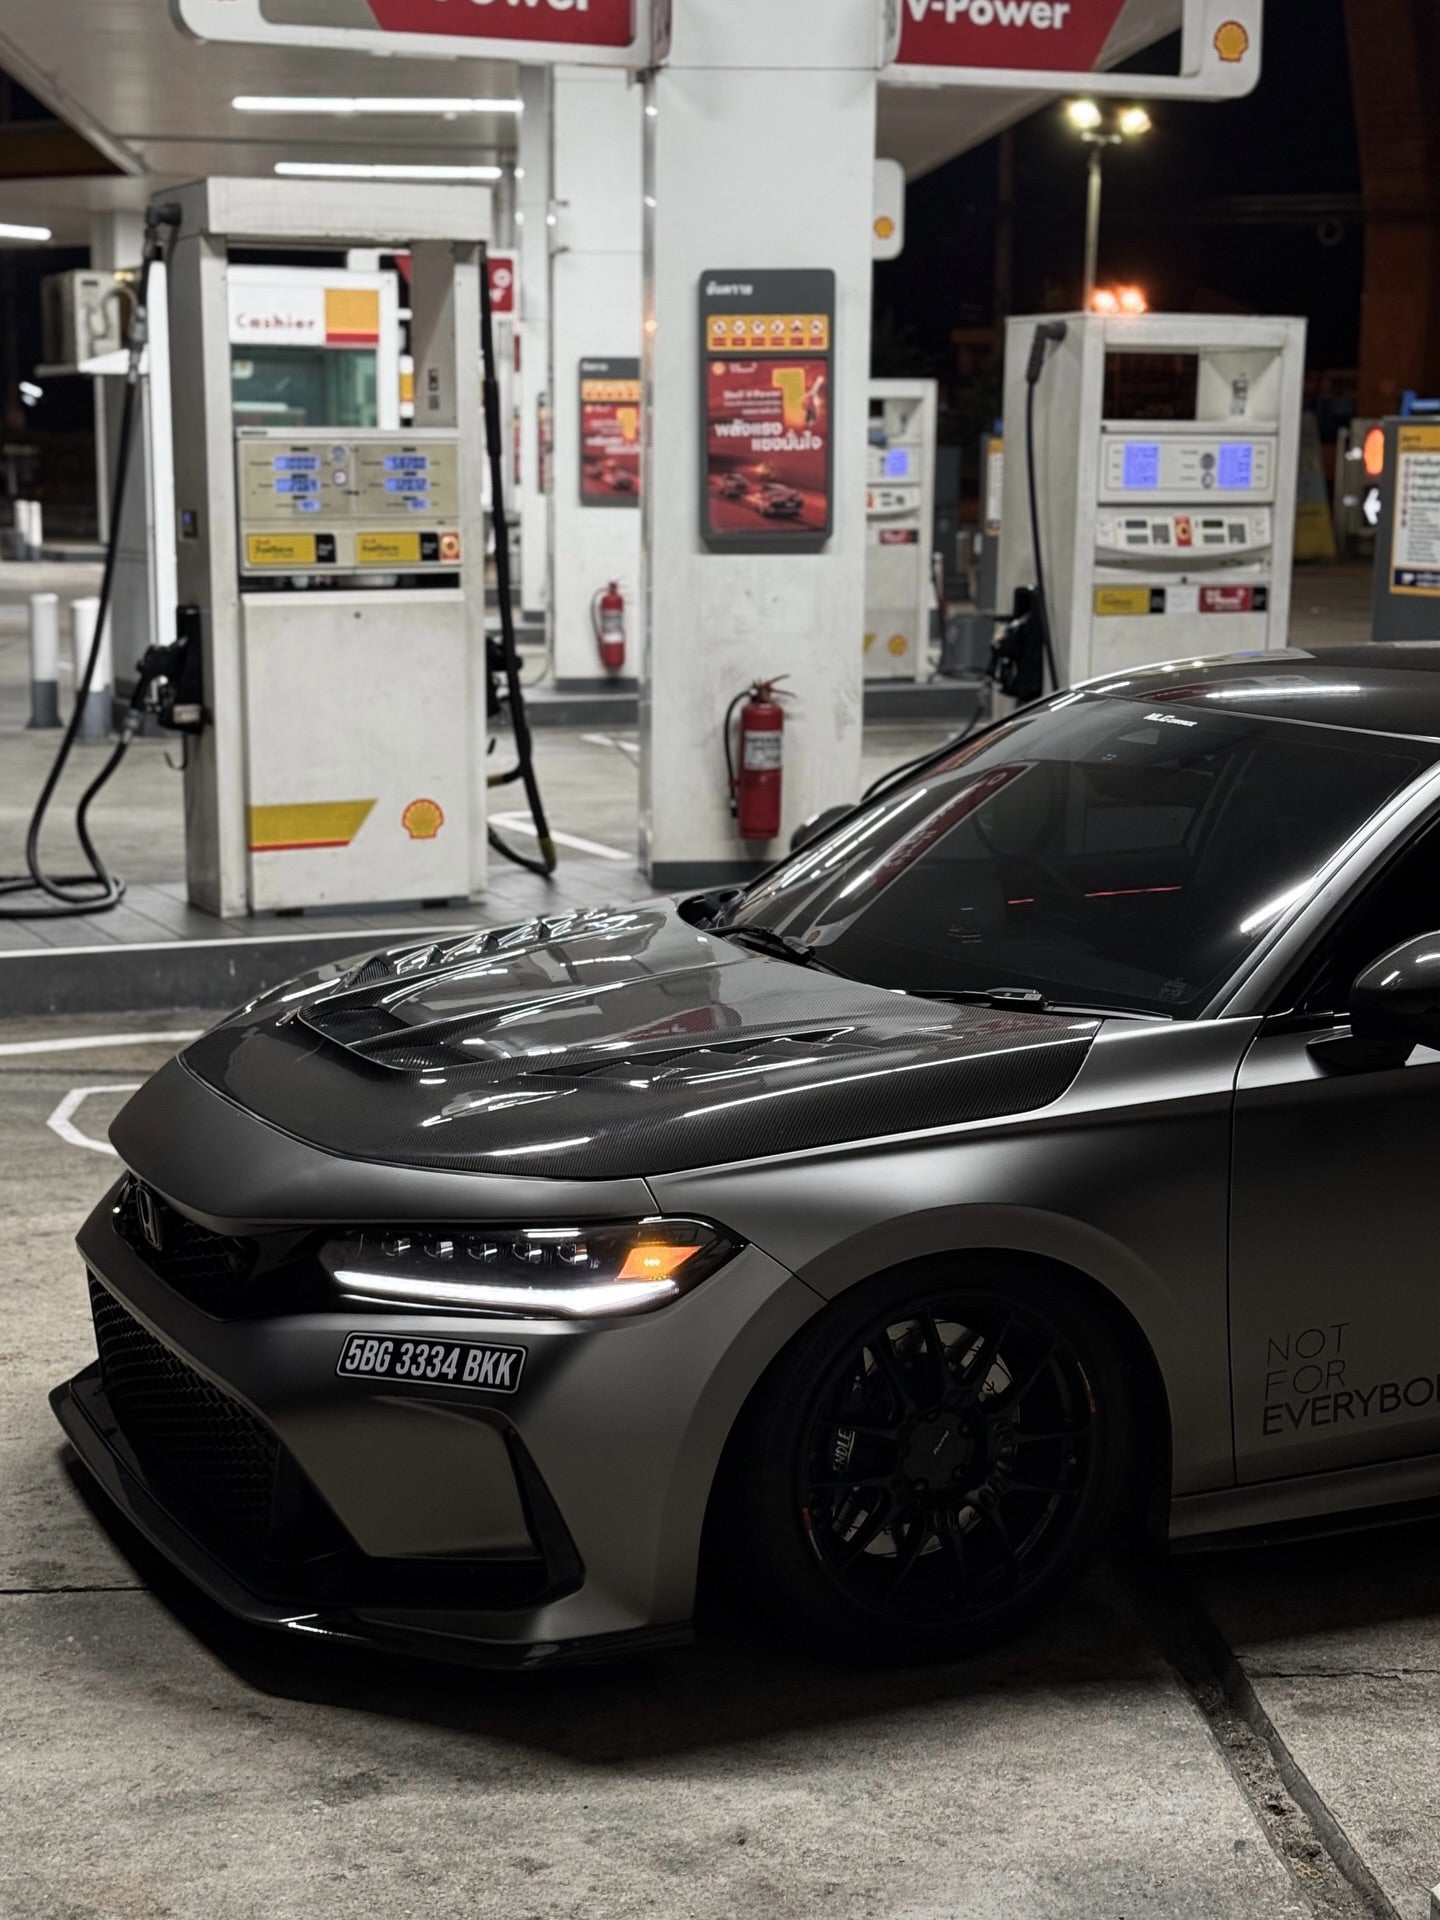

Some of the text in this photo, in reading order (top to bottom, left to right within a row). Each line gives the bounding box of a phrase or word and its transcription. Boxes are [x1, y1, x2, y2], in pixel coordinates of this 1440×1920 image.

[907, 0, 1071, 29] V-Power
[236, 313, 316, 329] Cashier
[345, 1339, 517, 1386] 5BG 3334 BKK
[1267, 1322, 1350, 1366] NOT
[1265, 1360, 1346, 1402] FOR
[1263, 1374, 1440, 1436] EVERYBO
